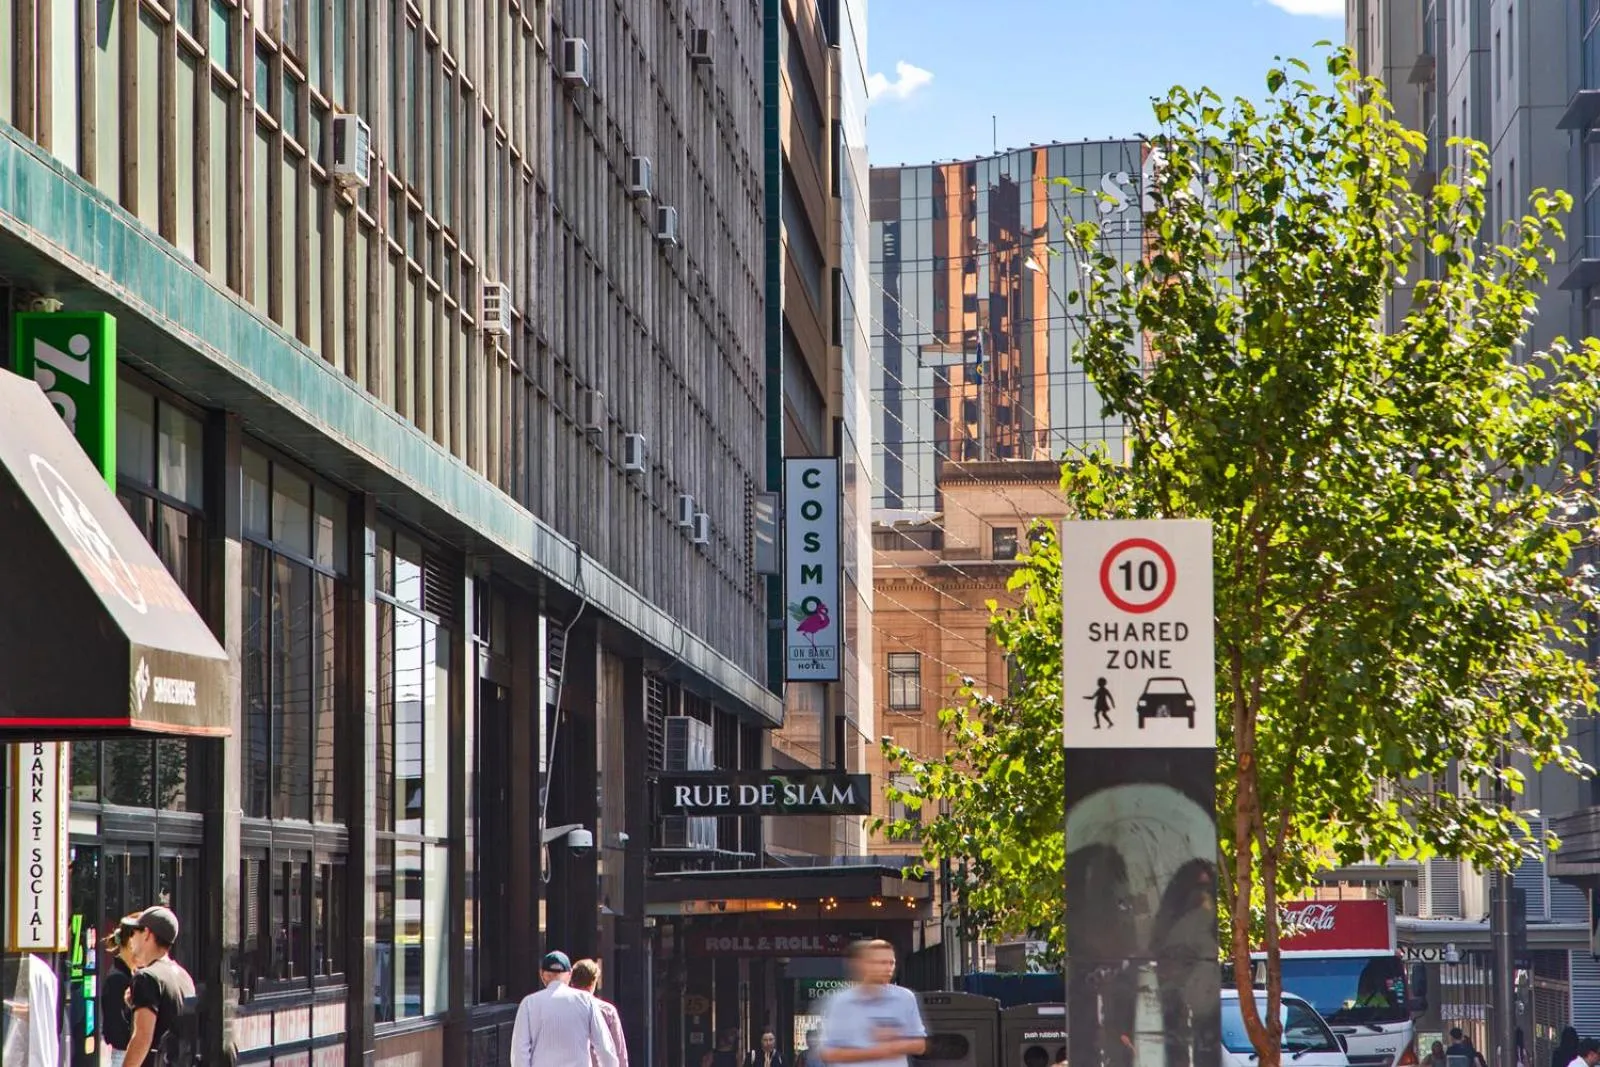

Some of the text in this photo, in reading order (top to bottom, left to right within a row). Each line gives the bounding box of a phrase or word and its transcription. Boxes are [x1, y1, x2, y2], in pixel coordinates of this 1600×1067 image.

[801, 468, 823, 616] COSMO
[1118, 560, 1158, 591] 10
[1088, 622, 1189, 642] SHARED
[793, 648, 831, 658] ON BANK
[1106, 649, 1172, 669] ZONE
[32, 742, 43, 802] BANK
[674, 783, 855, 807] RUE DE SIAM
[30, 848, 43, 941] SOCIAL
[705, 935, 823, 950] ROLL & ROLL
